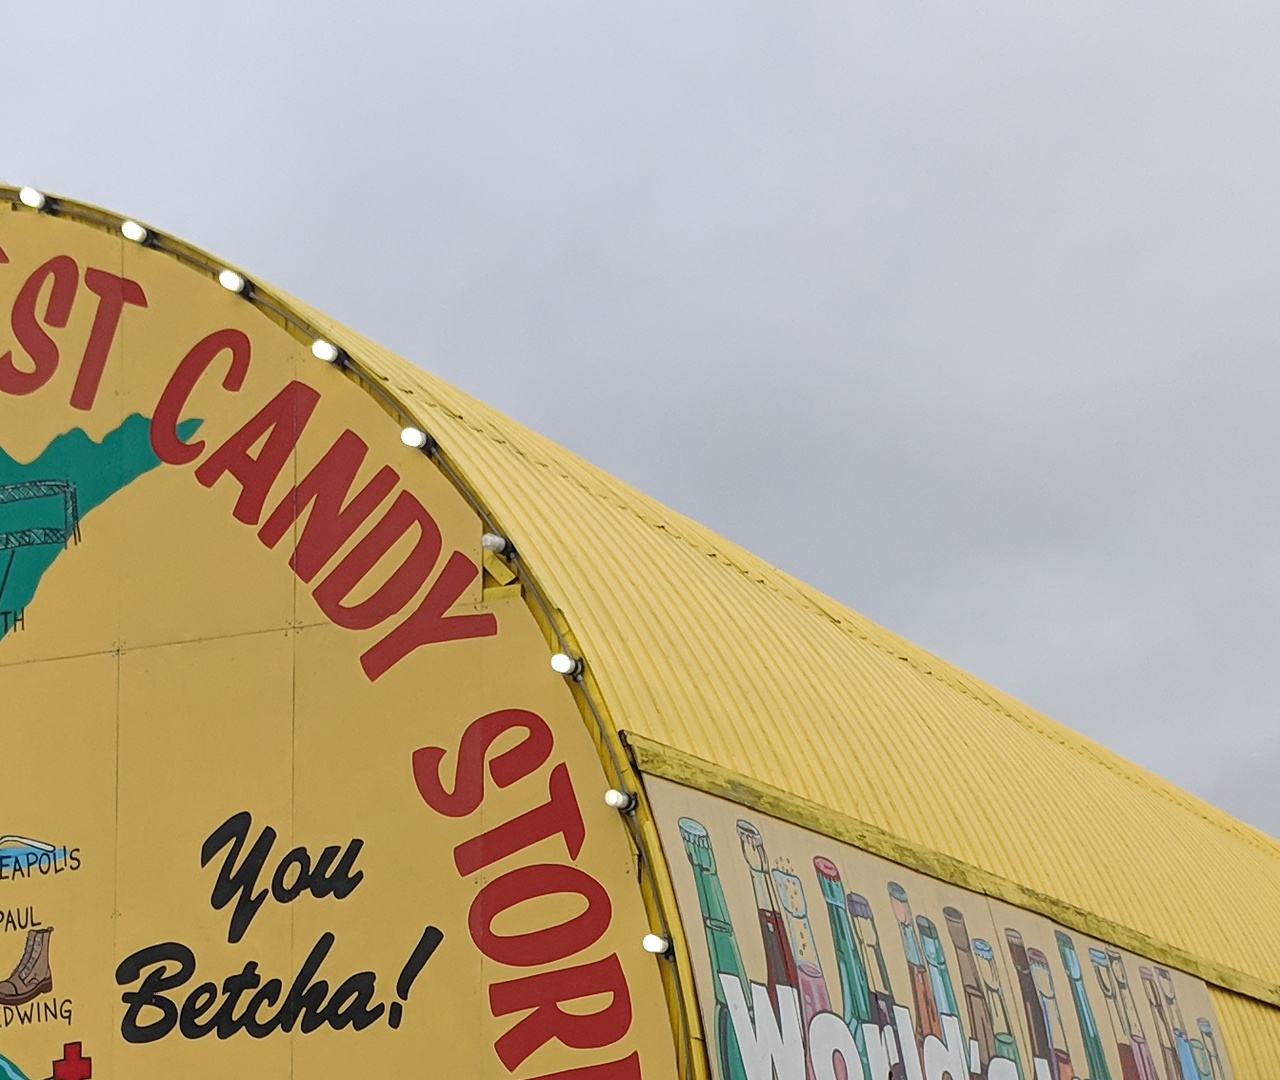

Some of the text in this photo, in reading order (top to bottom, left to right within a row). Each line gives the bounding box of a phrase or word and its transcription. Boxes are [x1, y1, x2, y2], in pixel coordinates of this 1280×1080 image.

[149, 328, 497, 682] CANDY
[200, 810, 365, 943] You
[114, 925, 444, 1044] Betcha!
